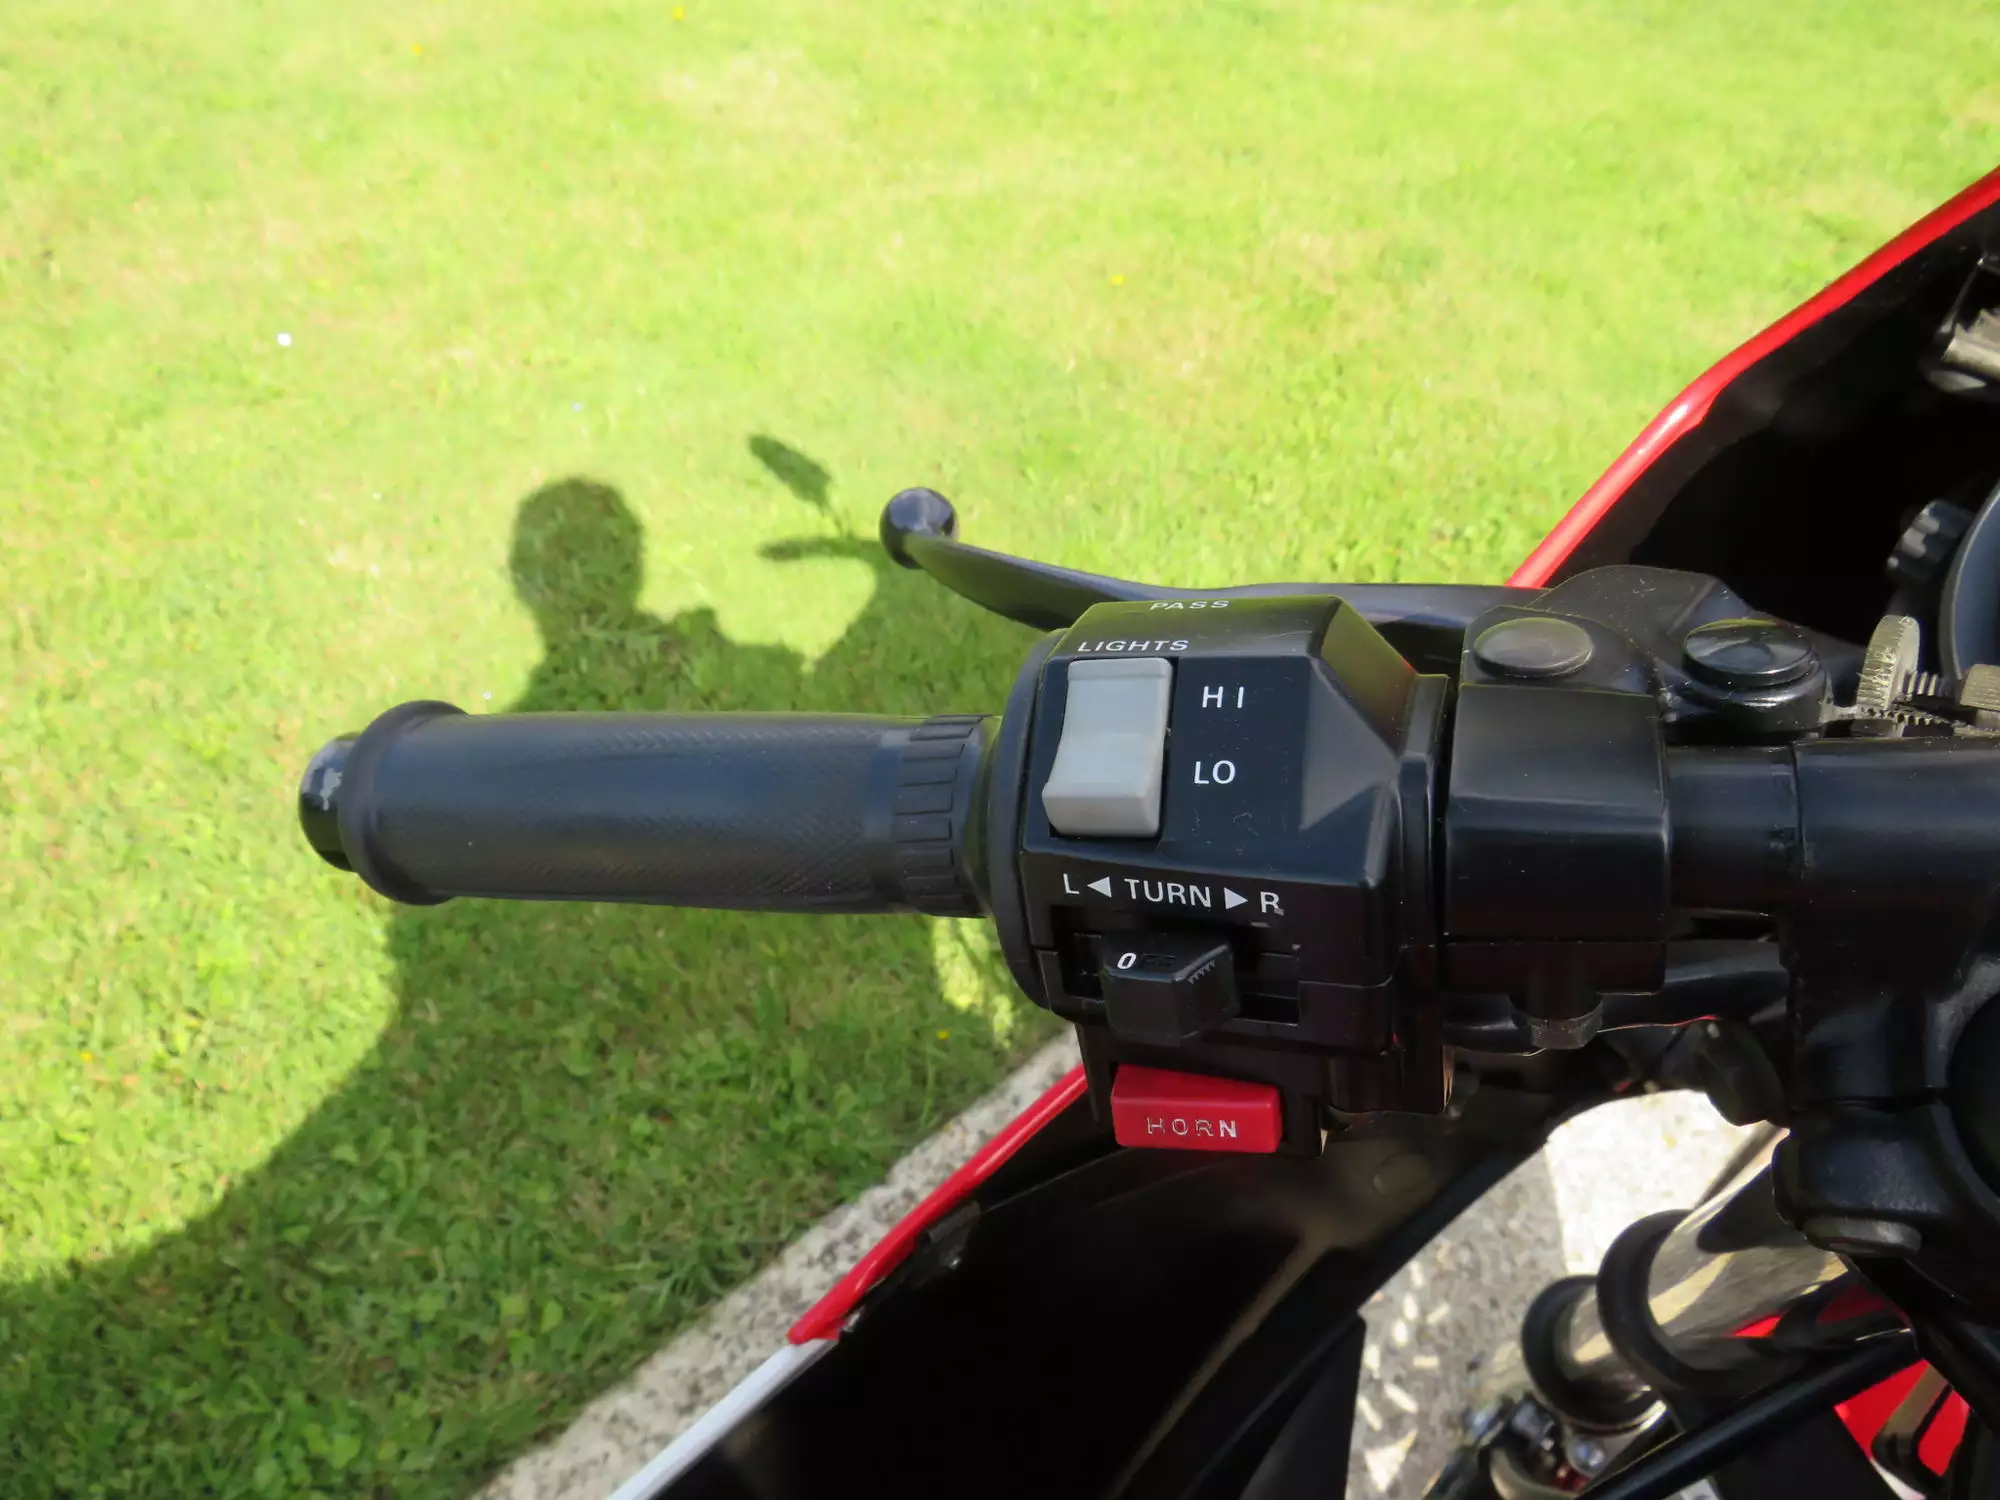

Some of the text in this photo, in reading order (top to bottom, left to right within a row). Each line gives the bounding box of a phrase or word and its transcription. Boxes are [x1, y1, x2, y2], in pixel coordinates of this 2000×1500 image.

[1150, 600, 1229, 610] PASS
[1077, 640, 1190, 652] LIGHTS
[1201, 686, 1244, 709] HI
[1194, 760, 1236, 784] LO
[1063, 873, 1282, 914] L TURN R
[1146, 1116, 1238, 1139] HORN
